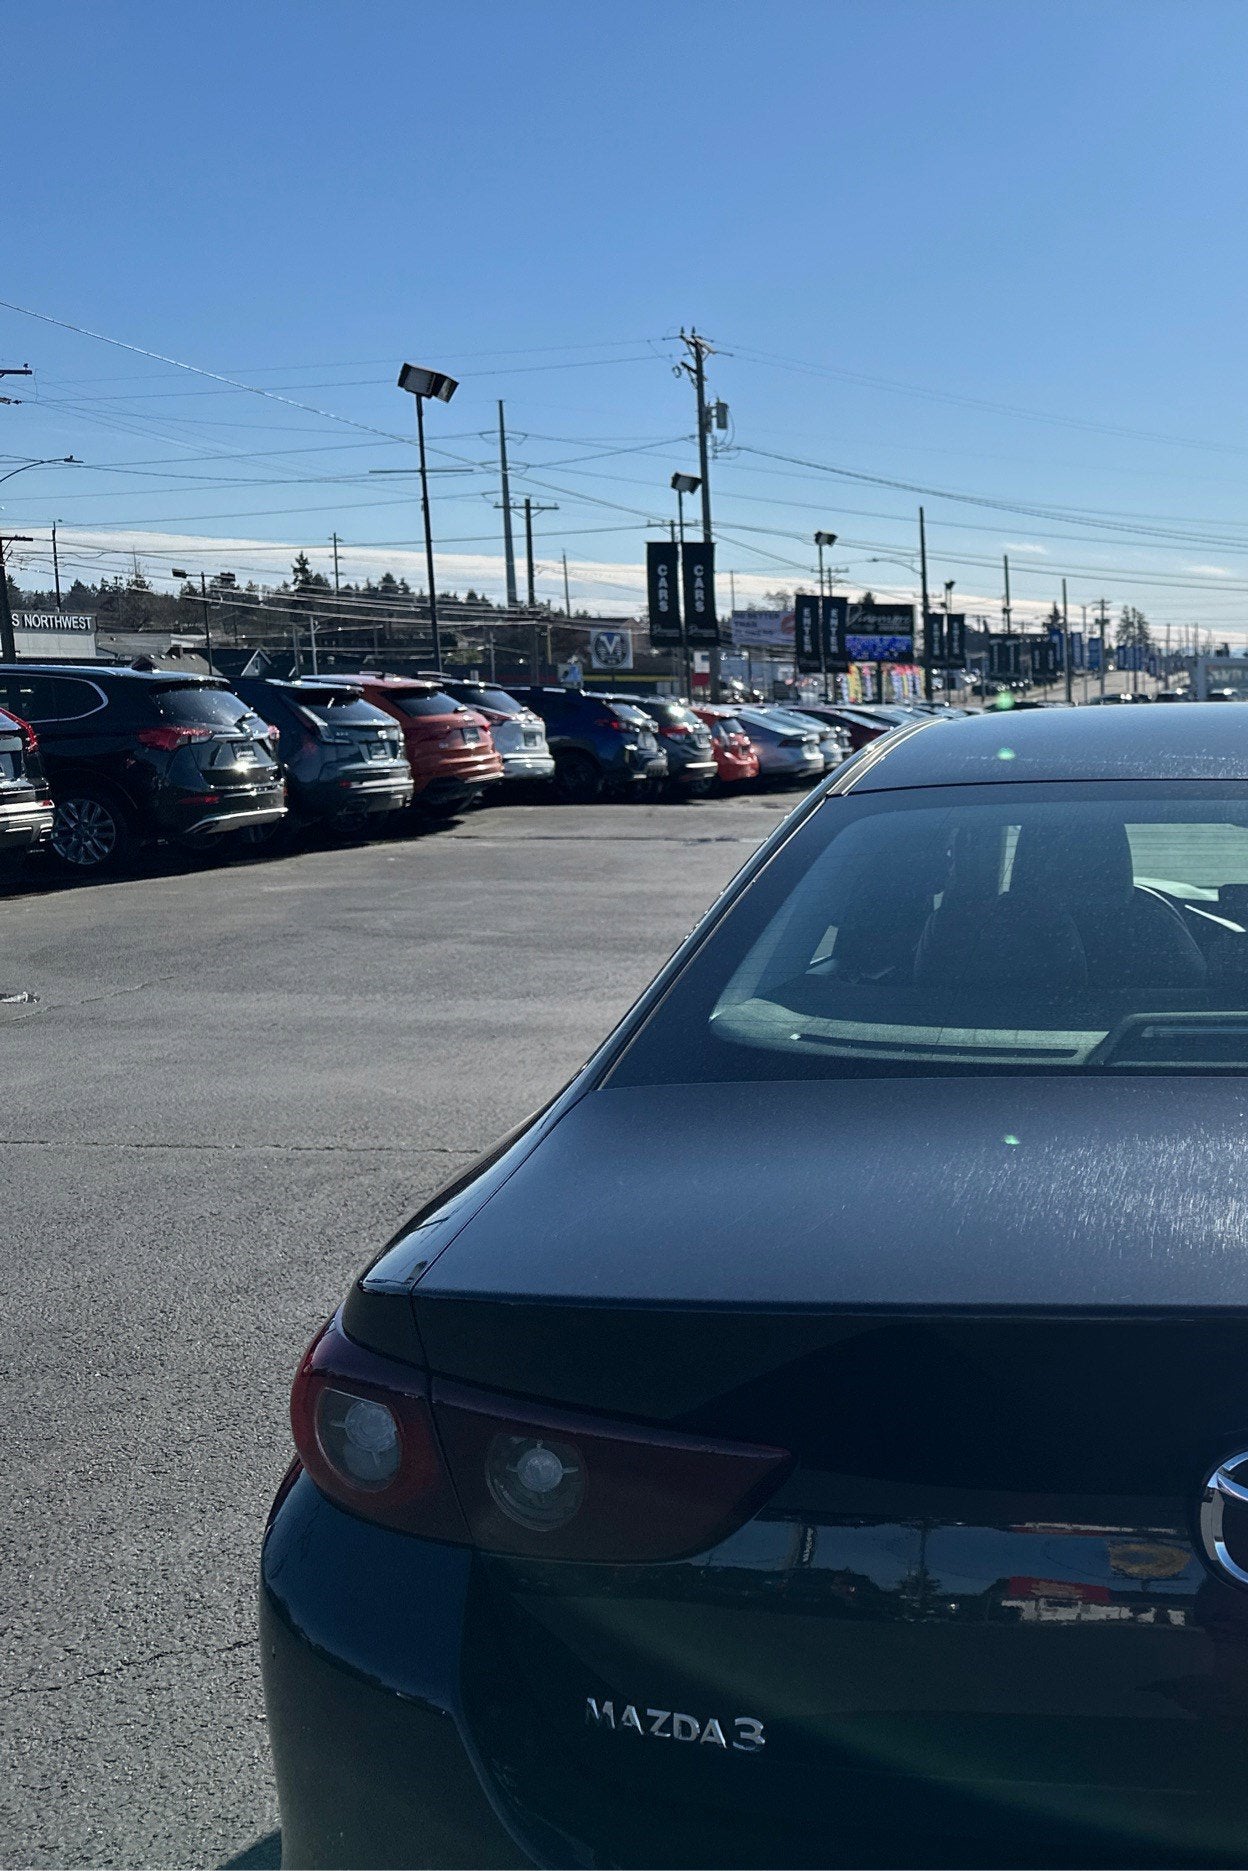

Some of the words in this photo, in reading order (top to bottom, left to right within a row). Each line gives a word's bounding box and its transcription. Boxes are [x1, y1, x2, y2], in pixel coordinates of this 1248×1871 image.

[657, 564, 669, 612] CARS
[693, 564, 705, 612] CARS
[24, 613, 92, 630] NORTHWEST
[585, 1697, 766, 1751] MAZDA3
